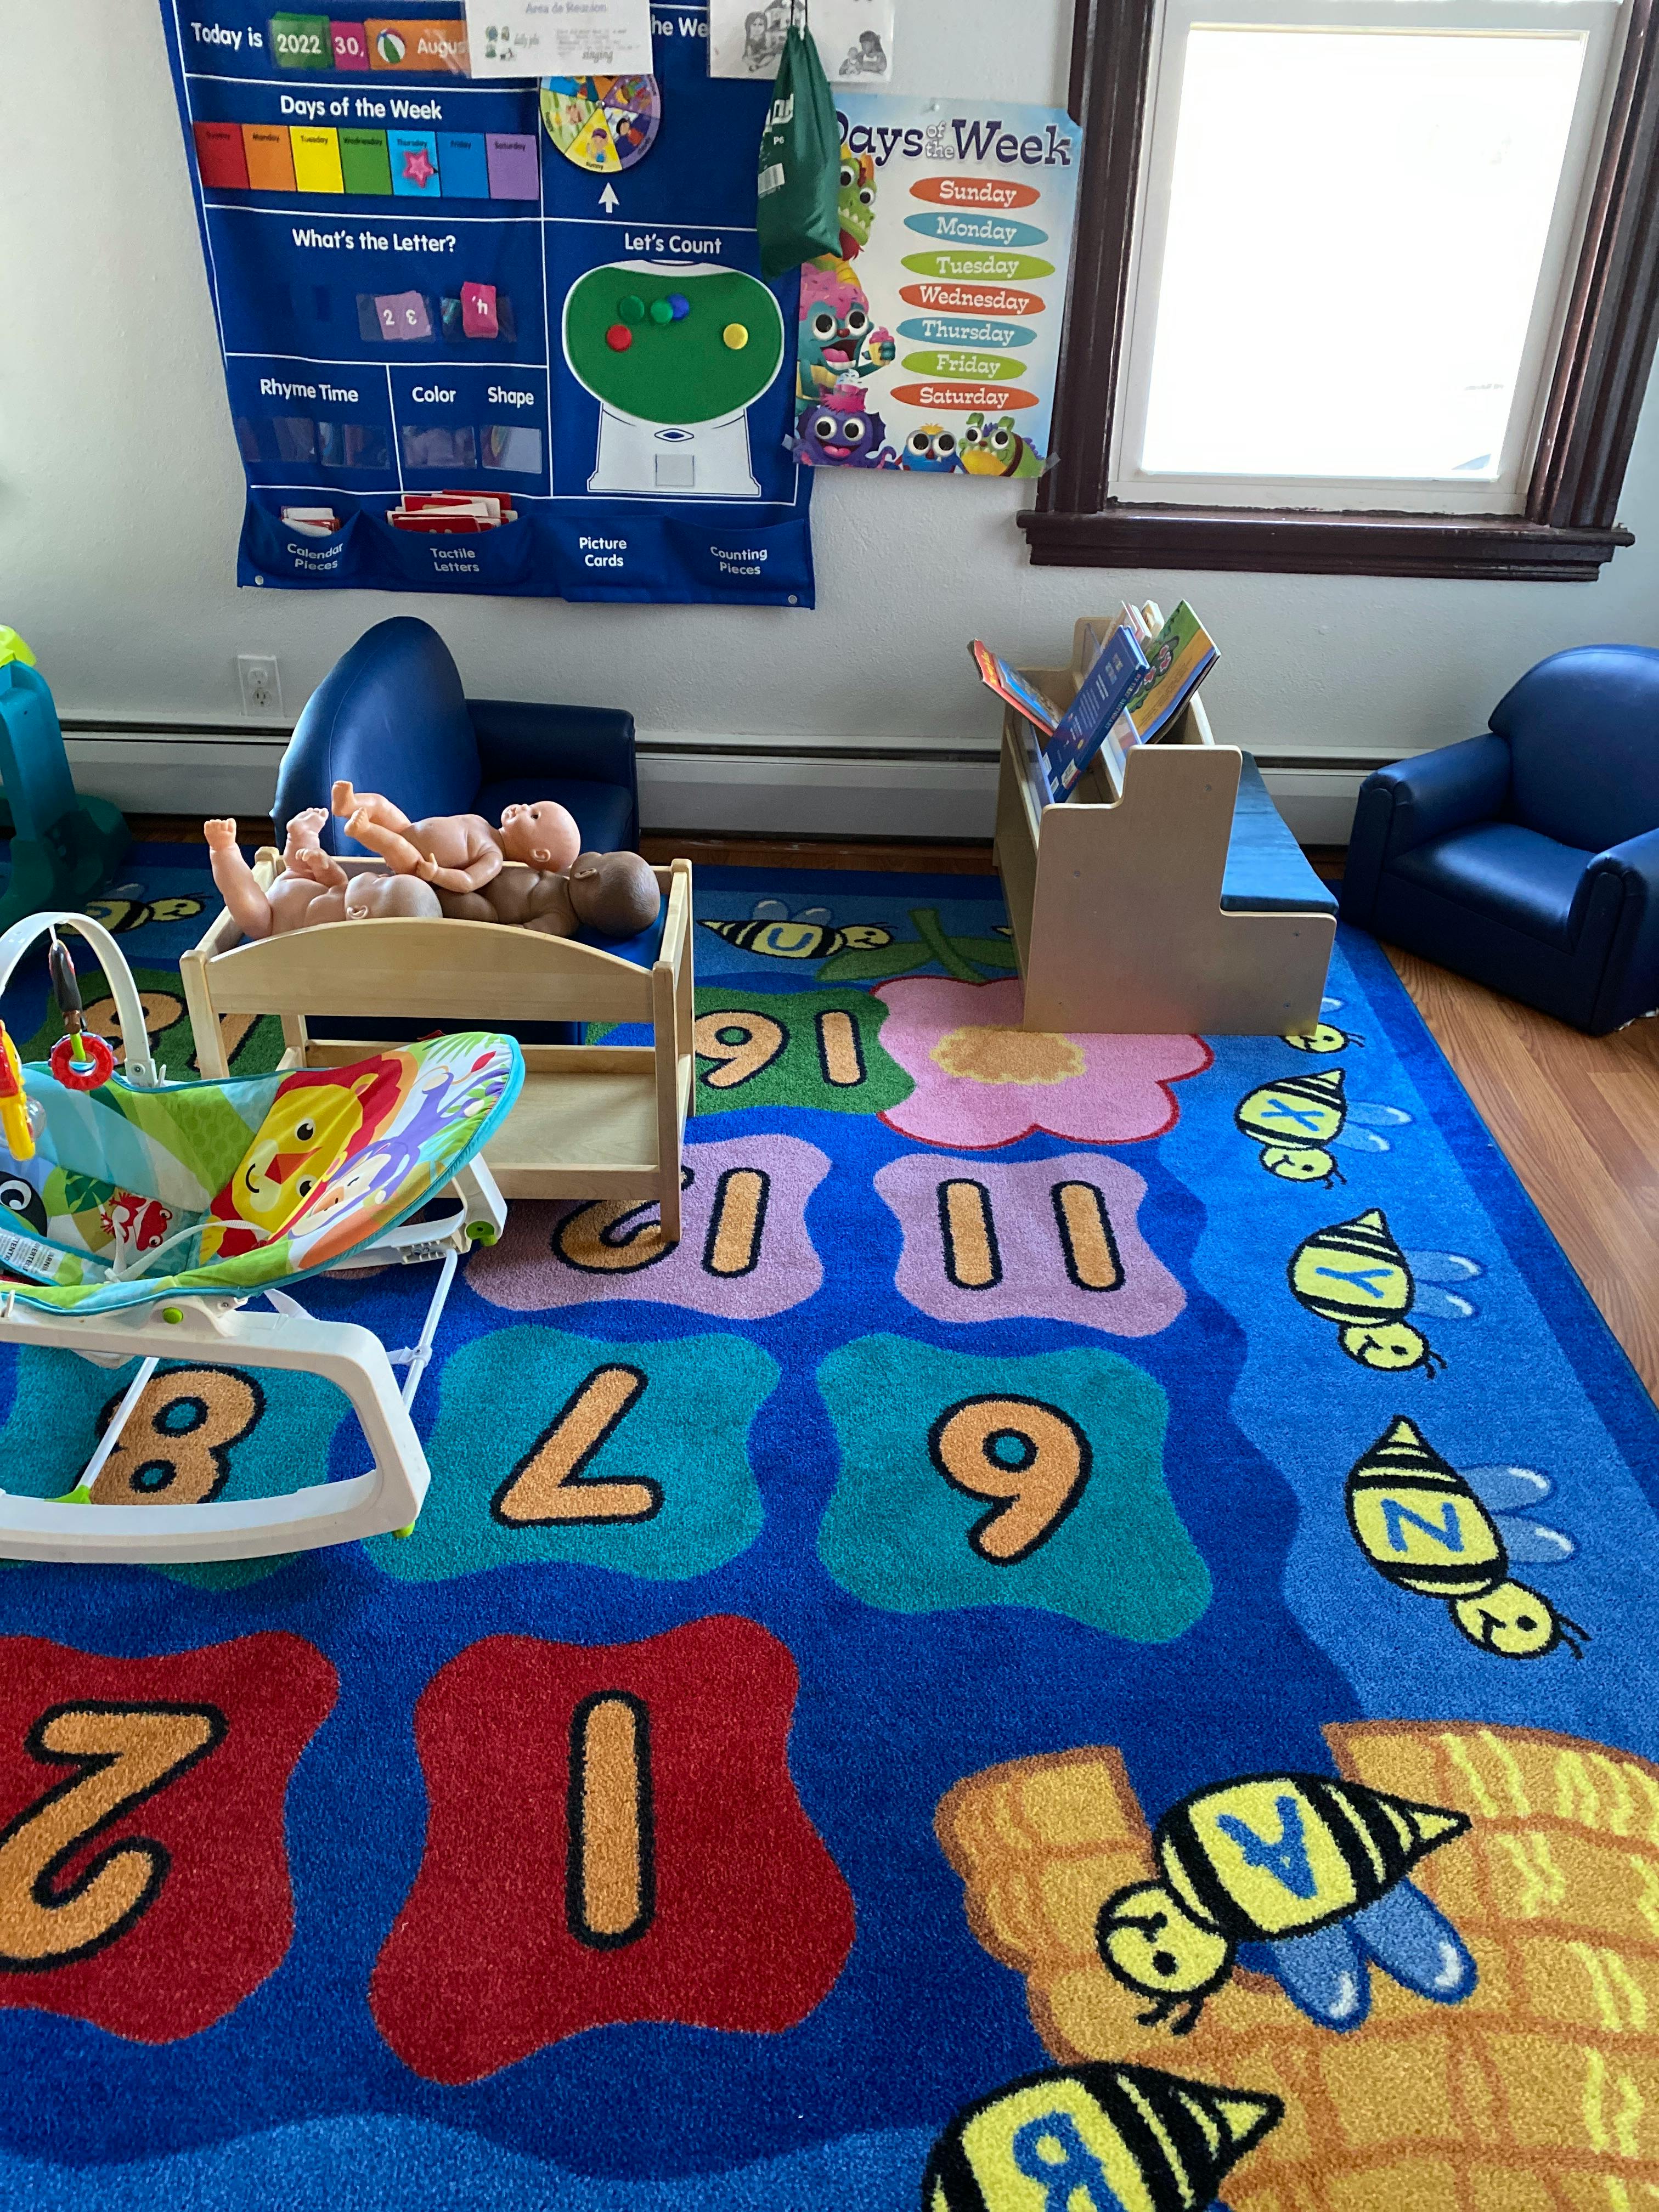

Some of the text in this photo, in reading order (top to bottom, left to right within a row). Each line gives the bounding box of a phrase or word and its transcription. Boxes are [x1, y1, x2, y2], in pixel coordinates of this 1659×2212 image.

[190, 22, 242, 50] Today
[247, 26, 263, 48] is
[277, 33, 322, 54] 2022
[335, 36, 364, 58] 30,
[280, 95, 443, 120] Days of the Week
[926, 121, 946, 138] of
[925, 140, 955, 159] the
[951, 118, 1071, 166] Week
[939, 179, 1018, 209] Sunday
[292, 228, 456, 252] What's the Letter?
[936, 216, 1018, 243] Monday
[624, 232, 722, 254] Let's Count
[936, 256, 1020, 281] Tuesday
[919, 285, 1029, 314] Wednesday
[922, 320, 1015, 347] Thursday
[936, 354, 1001, 377] Friday
[260, 379, 359, 403] Rhyme Time
[411, 386, 456, 403] Color
[488, 386, 534, 409] Shape
[919, 386, 1010, 410] Saturday
[287, 543, 344, 560] Calendar
[430, 548, 476, 560] Tactile
[579, 537, 628, 550] Picture
[710, 546, 768, 561] Counting
[295, 558, 338, 571] Pieces
[435, 561, 479, 573] Letters
[584, 554, 624, 567] Cards
[719, 561, 761, 575] Pieces
[767, 927, 813, 951] U
[1261, 1098, 1324, 1132] X
[937, 1177, 1126, 1293] 11
[1315, 1266, 1395, 1299] Y
[71, 1363, 268, 1504] 8
[489, 1363, 664, 1530] 7
[1380, 1498, 1465, 1554] Z
[565, 1689, 657, 1952] 1
[0, 1700, 229, 1973] 2
[1217, 1795, 1317, 1899] A
